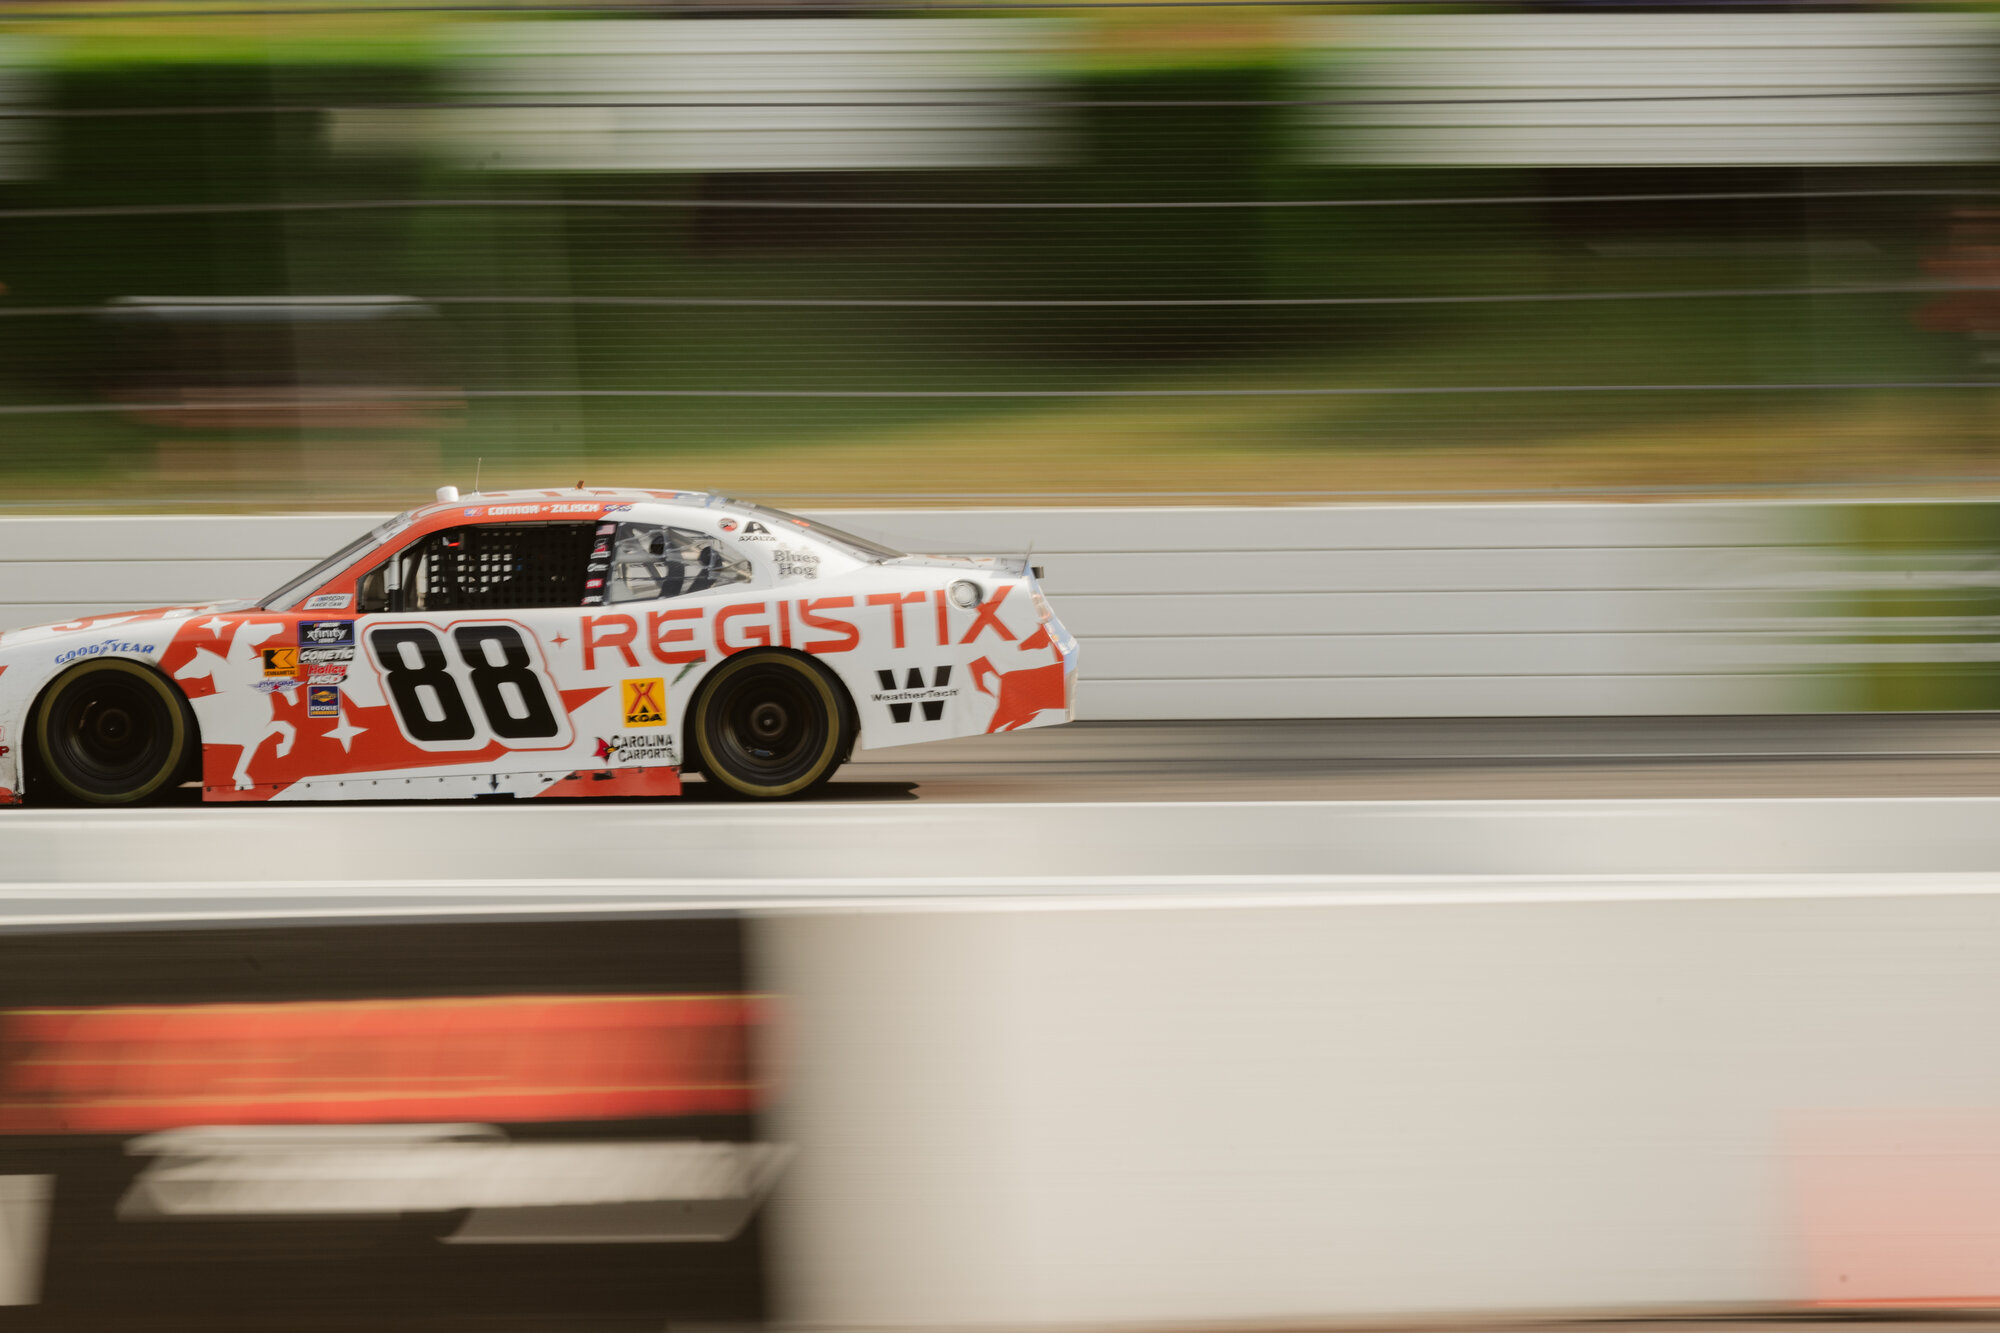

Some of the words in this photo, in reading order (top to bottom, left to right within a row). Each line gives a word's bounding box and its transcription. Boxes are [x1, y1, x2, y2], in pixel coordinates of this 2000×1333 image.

[488, 504, 540, 516] CONNOR
[551, 503, 599, 513] ZILISCH
[773, 550, 820, 563] Blues
[778, 563, 817, 579] Hog
[307, 627, 348, 641] xfinity
[580, 585, 1017, 671] REGISTIX
[55, 639, 154, 664] GOODYEAR
[300, 649, 354, 661] COMETIC
[308, 663, 347, 676] Holley
[370, 625, 559, 742] 88
[871, 690, 958, 701] WeatherTech
[626, 713, 662, 723] KOA
[610, 734, 673, 750] CAROLINA
[618, 747, 674, 762] CARPORTS
